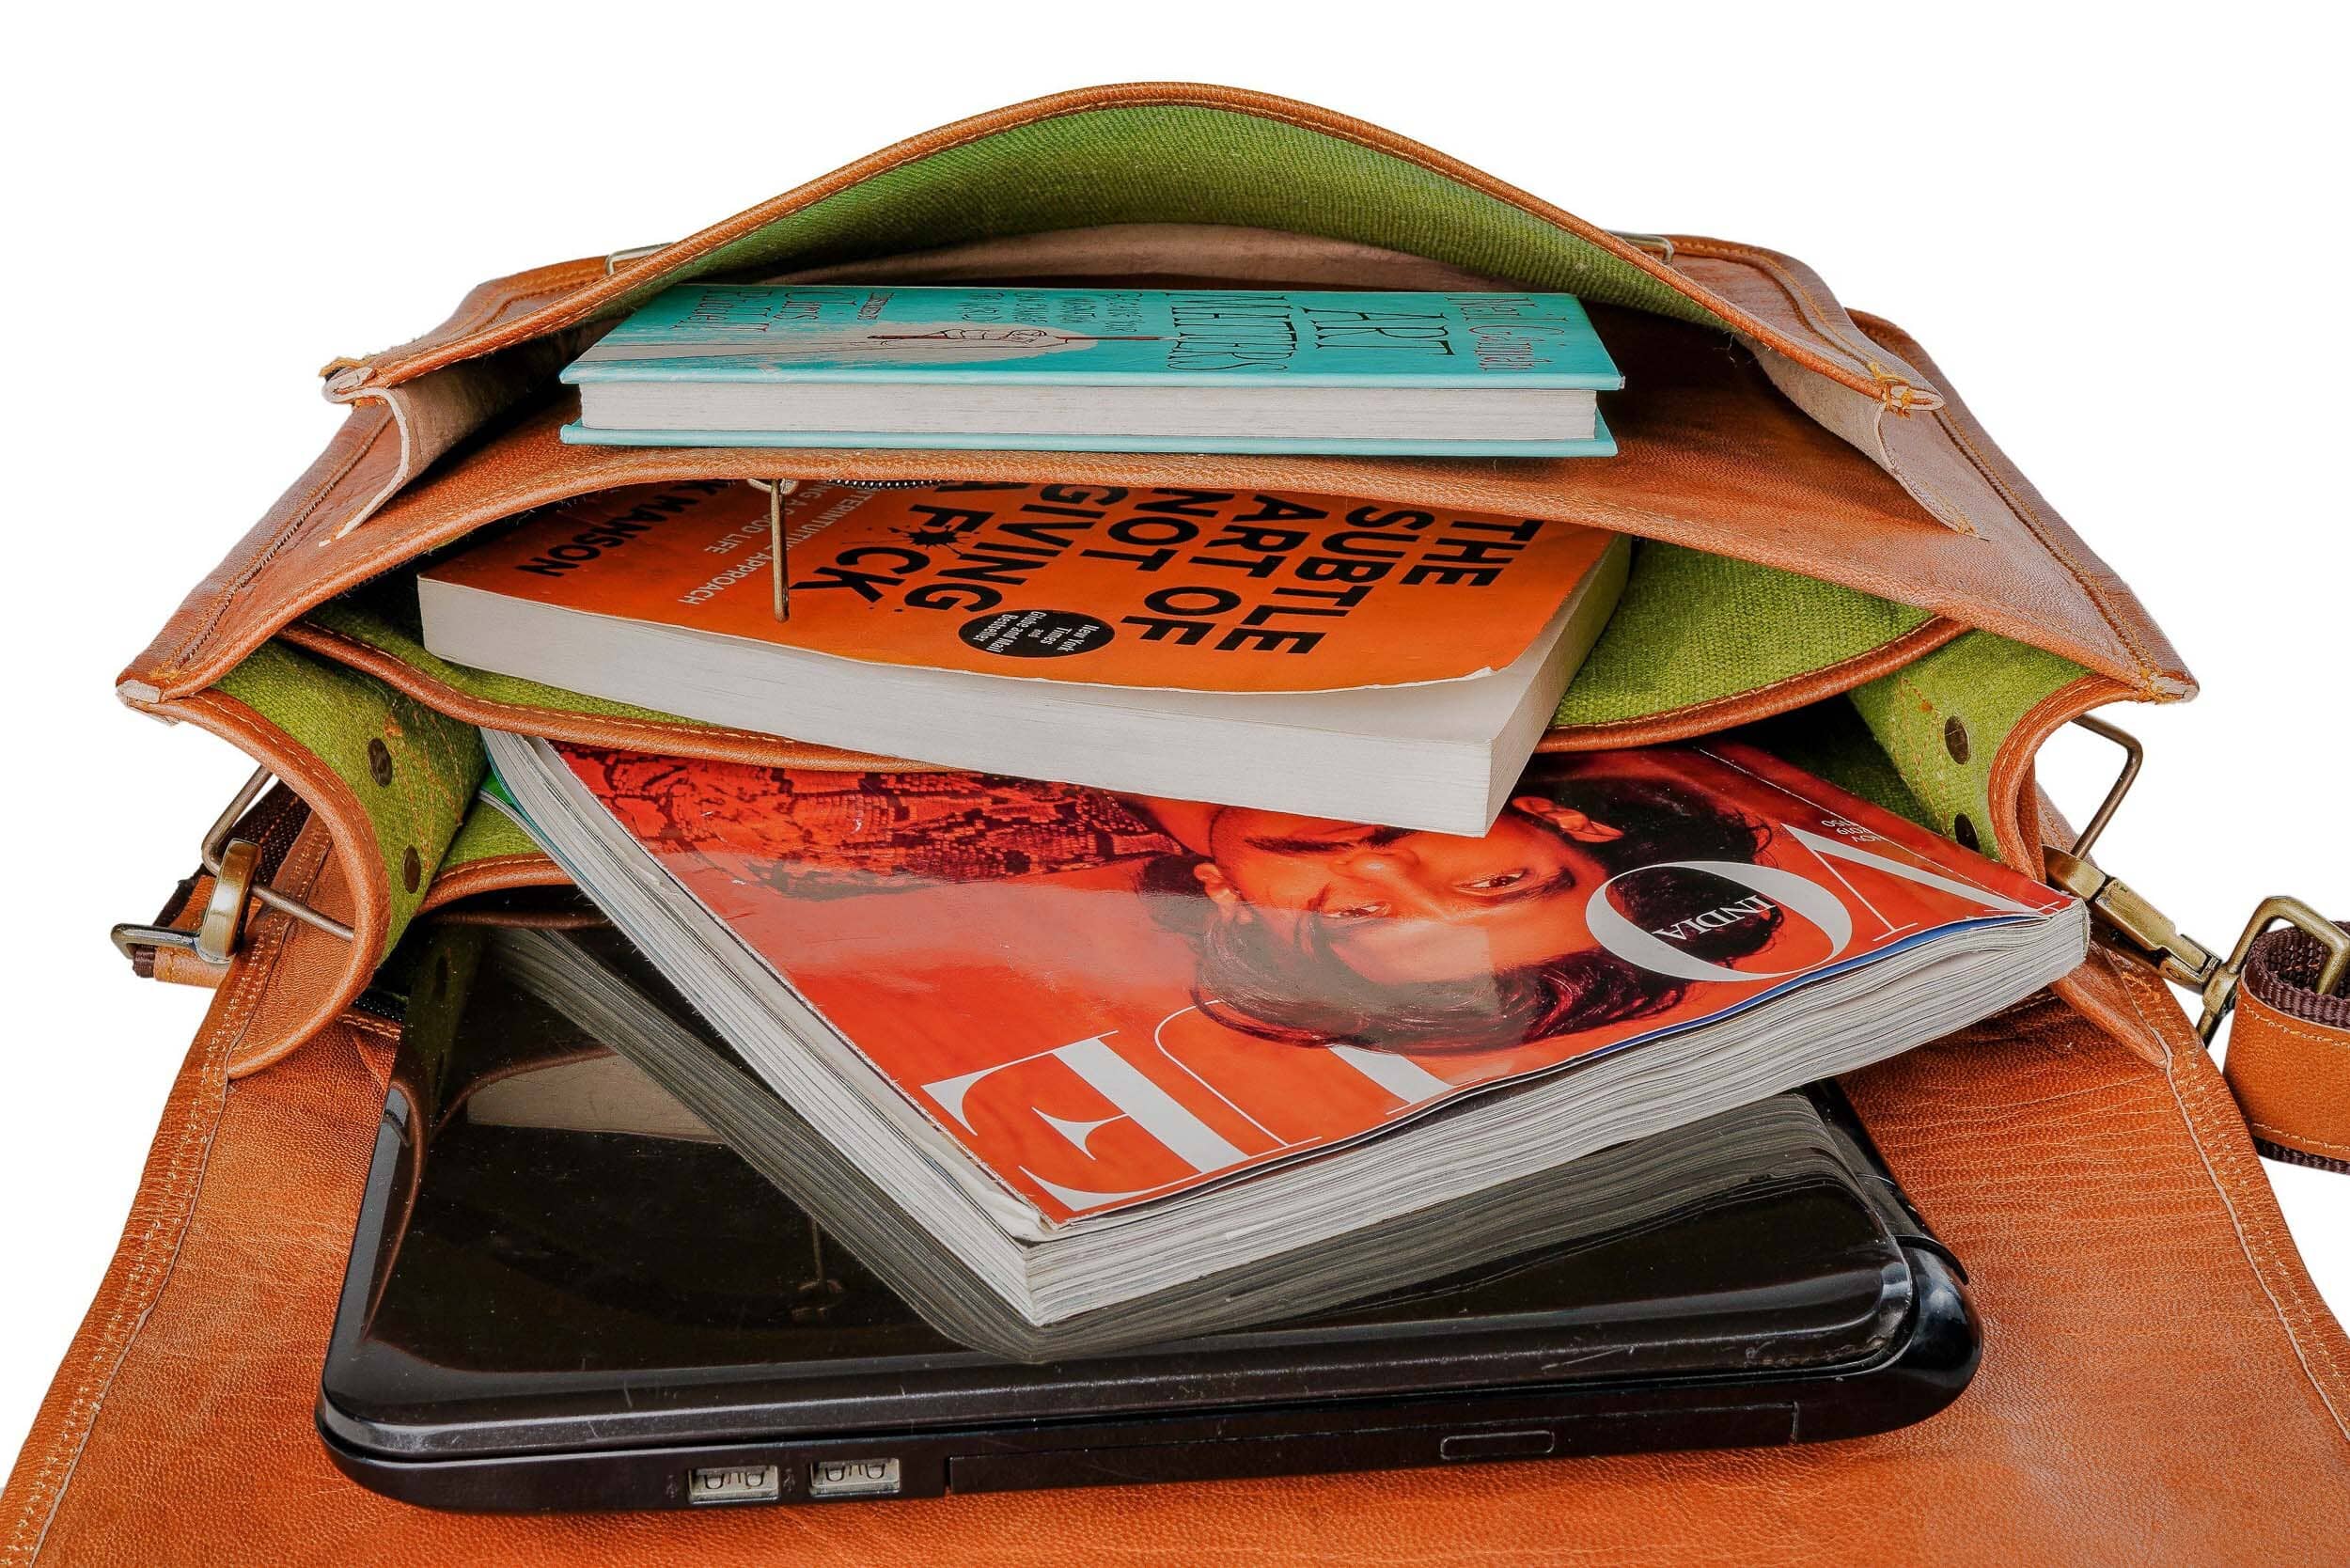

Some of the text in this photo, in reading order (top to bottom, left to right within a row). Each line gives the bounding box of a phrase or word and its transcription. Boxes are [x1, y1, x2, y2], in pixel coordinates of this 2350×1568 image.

[1165, 292, 1299, 370] MATTERS
[1299, 306, 1455, 356] ART
[1446, 296, 1569, 371] Neil Gaiman
[515, 494, 699, 577] MANSON
[704, 533, 753, 556] LIFE
[904, 483, 1132, 613] GIVING
[1079, 486, 1233, 572] NOT
[1399, 519, 1543, 587] THE
[677, 552, 773, 604] APPROACH
[1120, 494, 1329, 646] ART OF
[1214, 506, 1435, 654] SUBTLE
[972, 614, 1019, 642] Bestseller
[986, 611, 1047, 653] Globe and Mail
[1040, 627, 1073, 645] Times
[1057, 624, 1100, 652] New York
[1652, 895, 1777, 940] INDIA
[920, 823, 2060, 1211] VOUE
